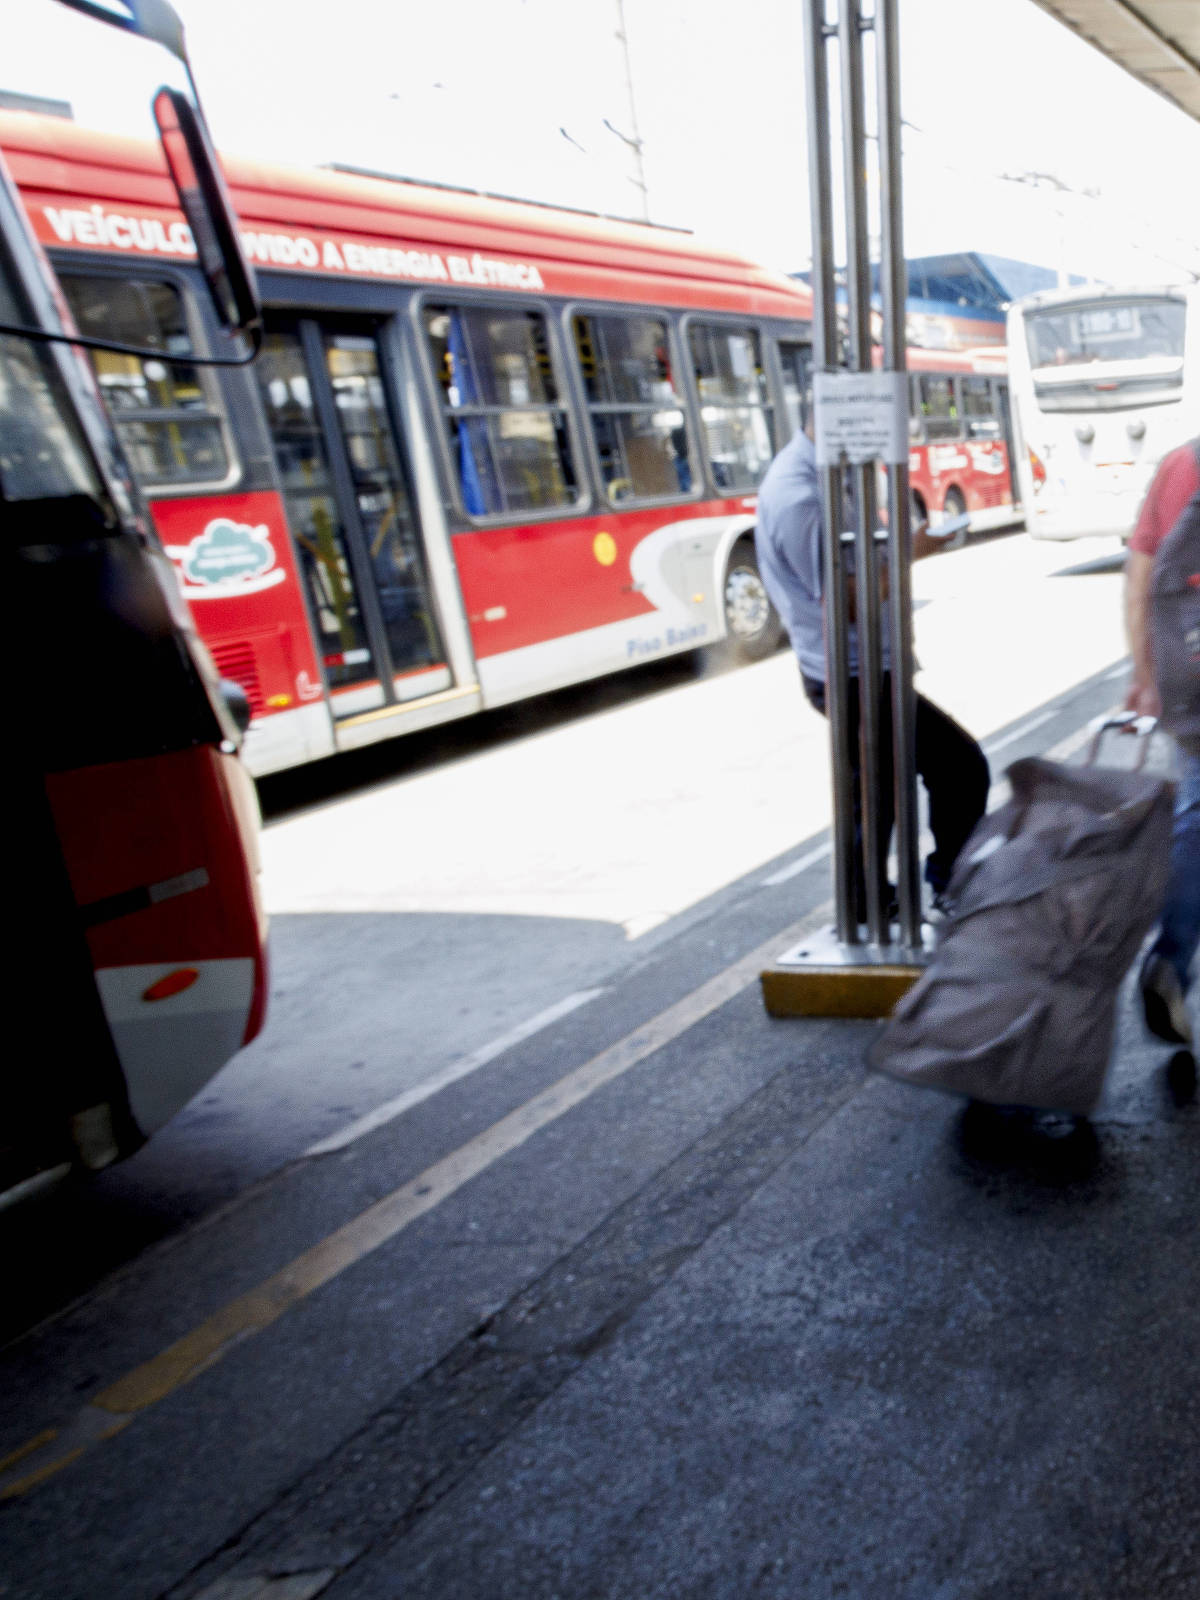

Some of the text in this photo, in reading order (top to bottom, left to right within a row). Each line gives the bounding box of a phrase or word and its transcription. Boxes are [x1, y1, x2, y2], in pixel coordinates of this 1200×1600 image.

[43, 205, 197, 254] VEÍCULO
[324, 241, 344, 269] A
[342, 243, 448, 280] ENERGIA
[447, 254, 544, 290] ELÉTRICA
